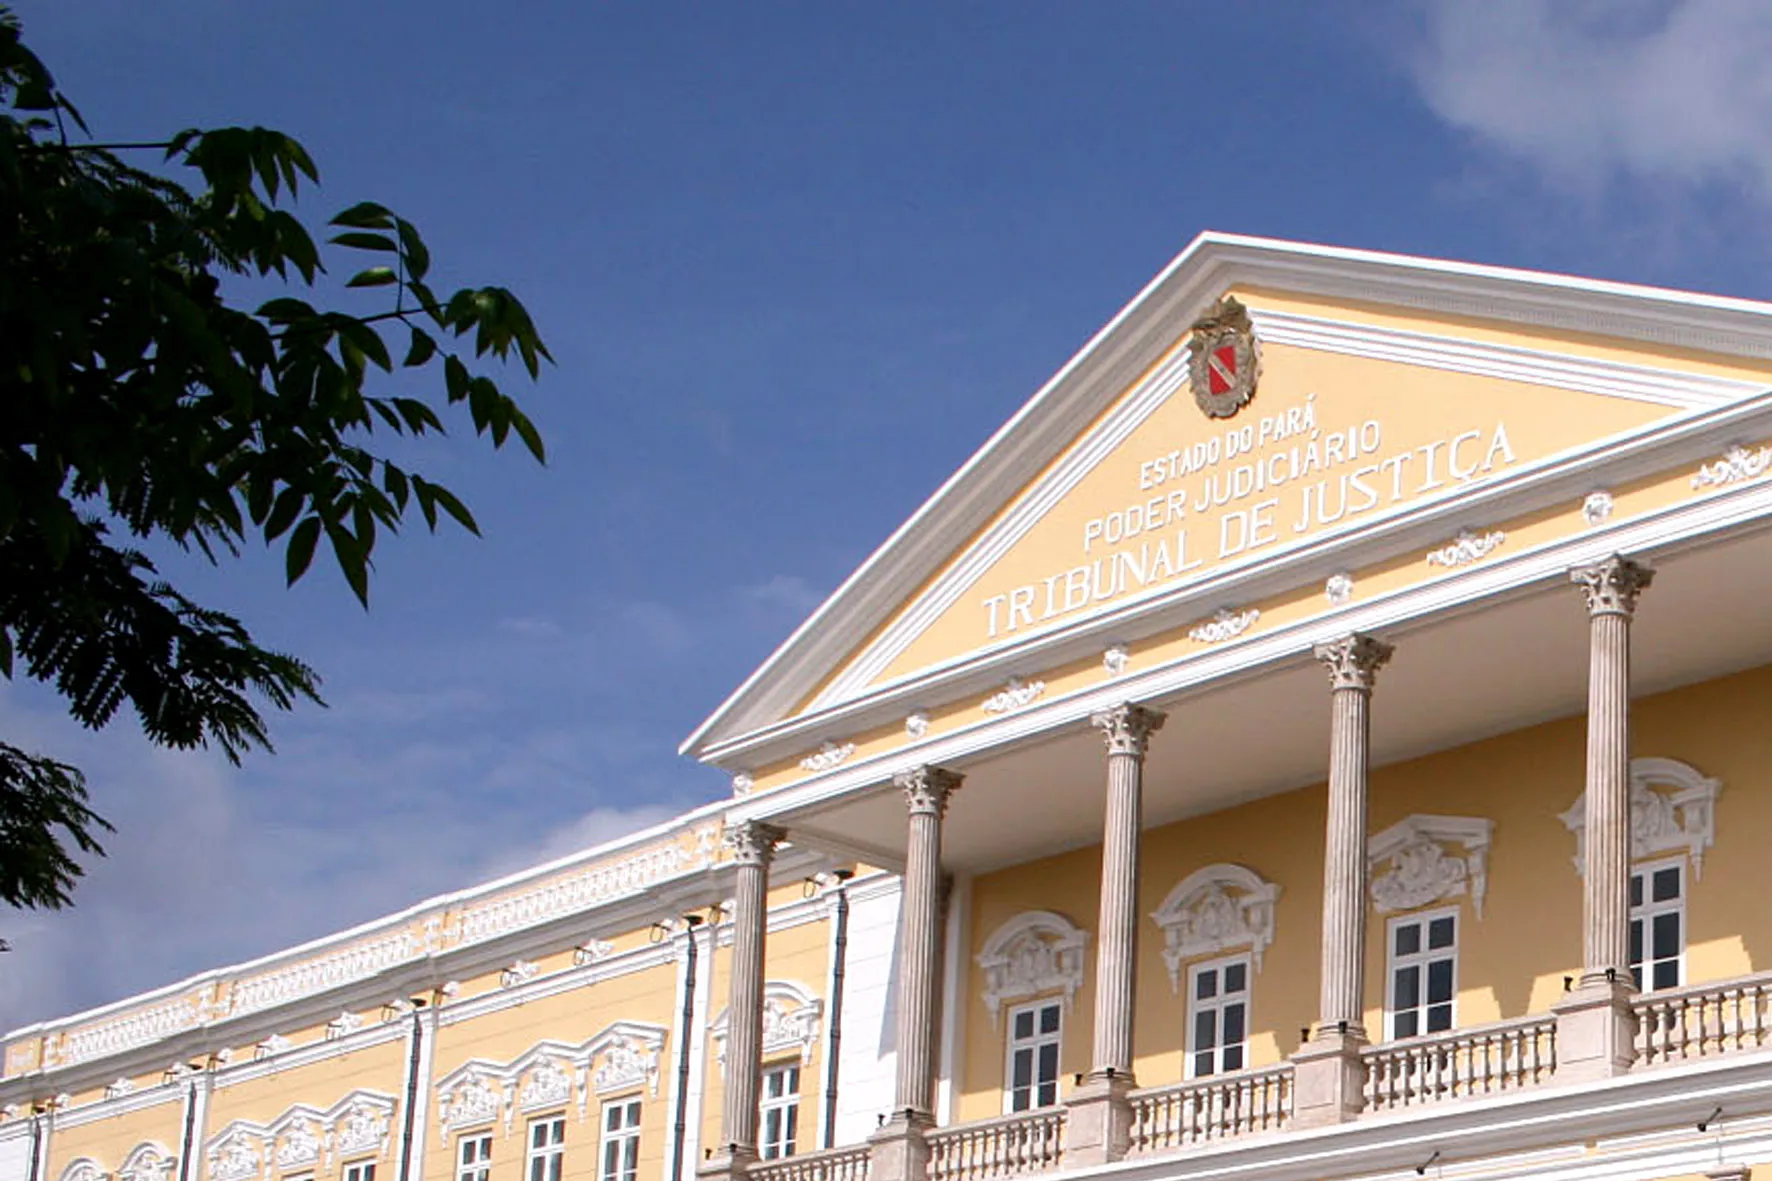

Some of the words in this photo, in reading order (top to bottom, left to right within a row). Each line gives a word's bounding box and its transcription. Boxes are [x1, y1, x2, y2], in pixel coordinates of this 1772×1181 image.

[1085, 490, 1186, 551] PODER
[1195, 421, 1380, 514] JUDICIÁRIO
[1139, 437, 1220, 491] ESTADO
[1225, 427, 1254, 457] DO
[1259, 393, 1318, 445] PARÁ
[983, 528, 1202, 636] TRIBUNAL
[1218, 500, 1278, 560] DE
[1293, 421, 1517, 534] JUSTIÇA
